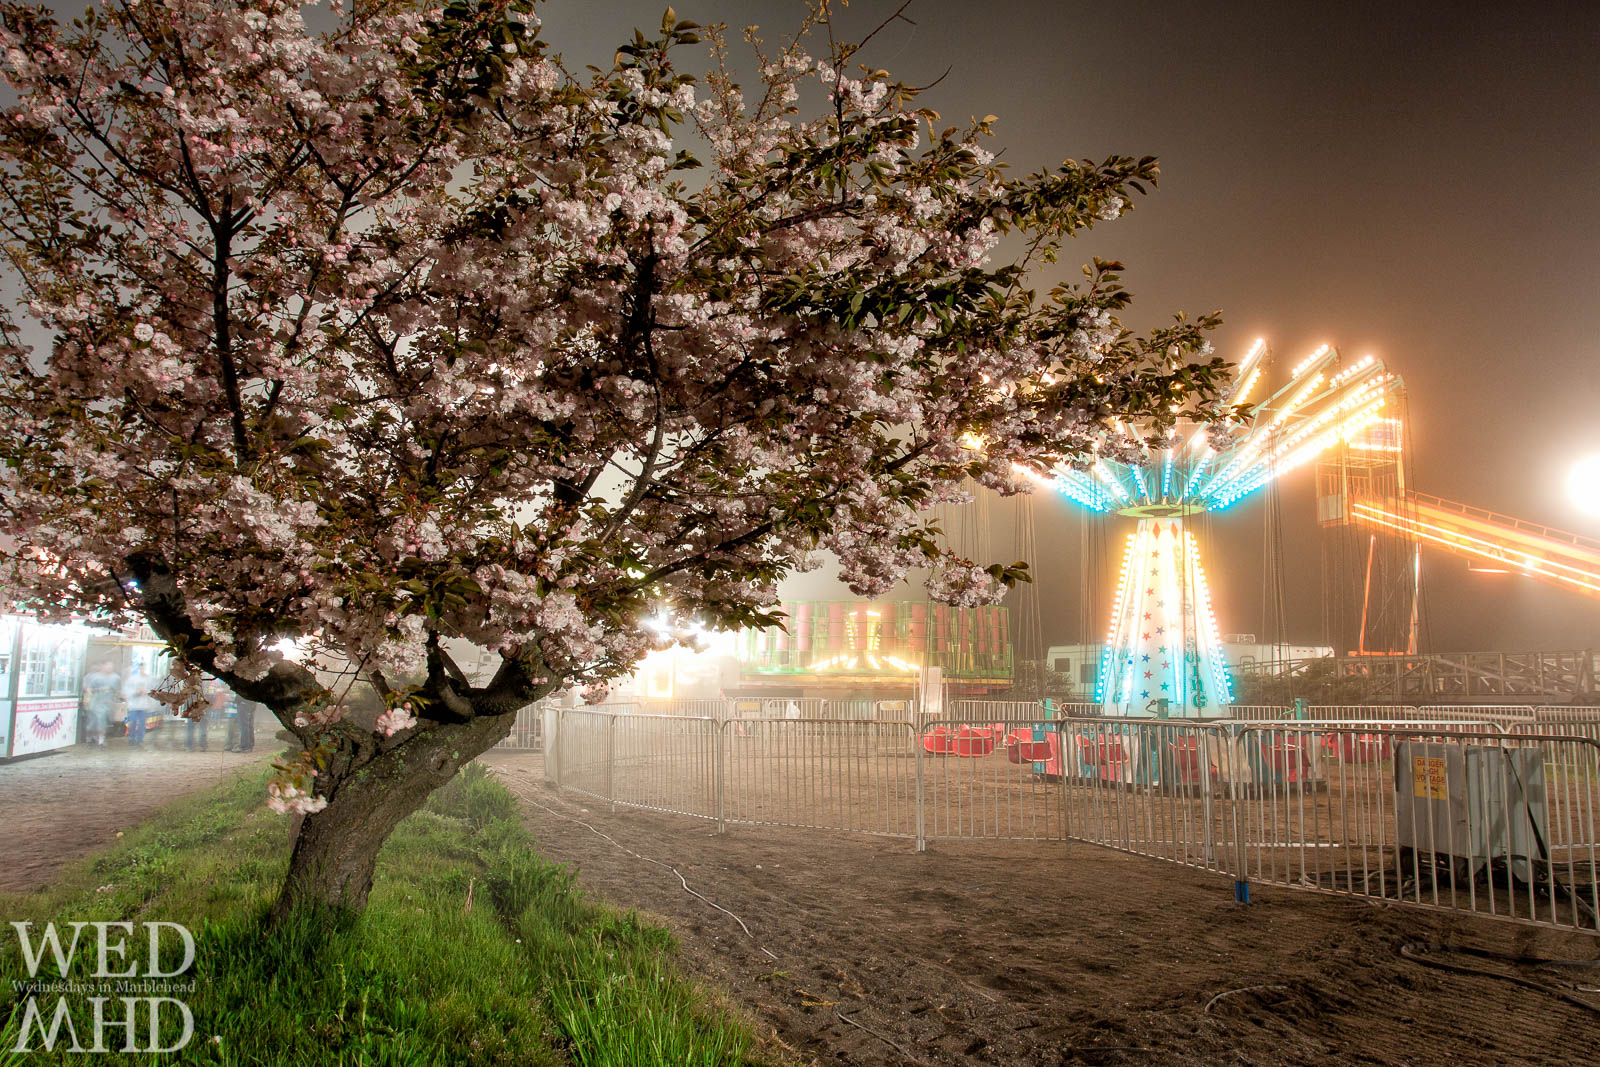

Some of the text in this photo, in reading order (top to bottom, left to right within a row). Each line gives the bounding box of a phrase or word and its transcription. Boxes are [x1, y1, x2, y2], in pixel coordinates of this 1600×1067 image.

[1417, 759, 1444, 768] DAGER
[1423, 767, 1439, 775] HGH
[1416, 774, 1445, 785] VOTAGE
